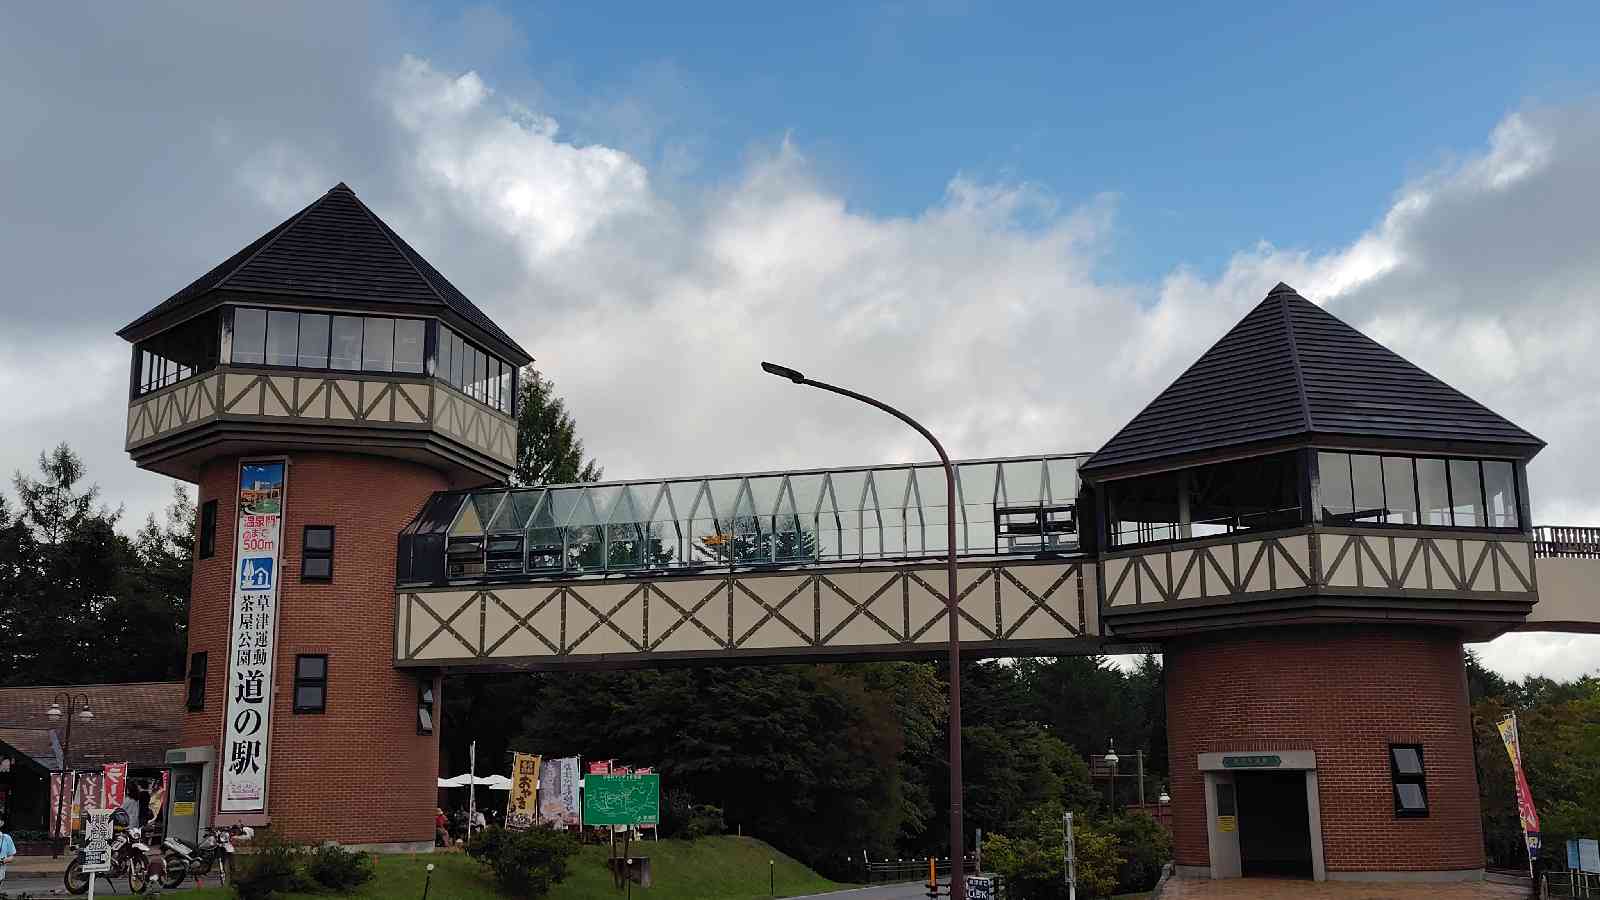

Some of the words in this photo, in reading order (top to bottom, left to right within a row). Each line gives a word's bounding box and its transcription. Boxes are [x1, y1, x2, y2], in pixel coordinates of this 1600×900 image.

[243, 539, 273, 550] 500m
[253, 594, 270, 666] 草津運動
[229, 669, 264, 775] 道の駅
